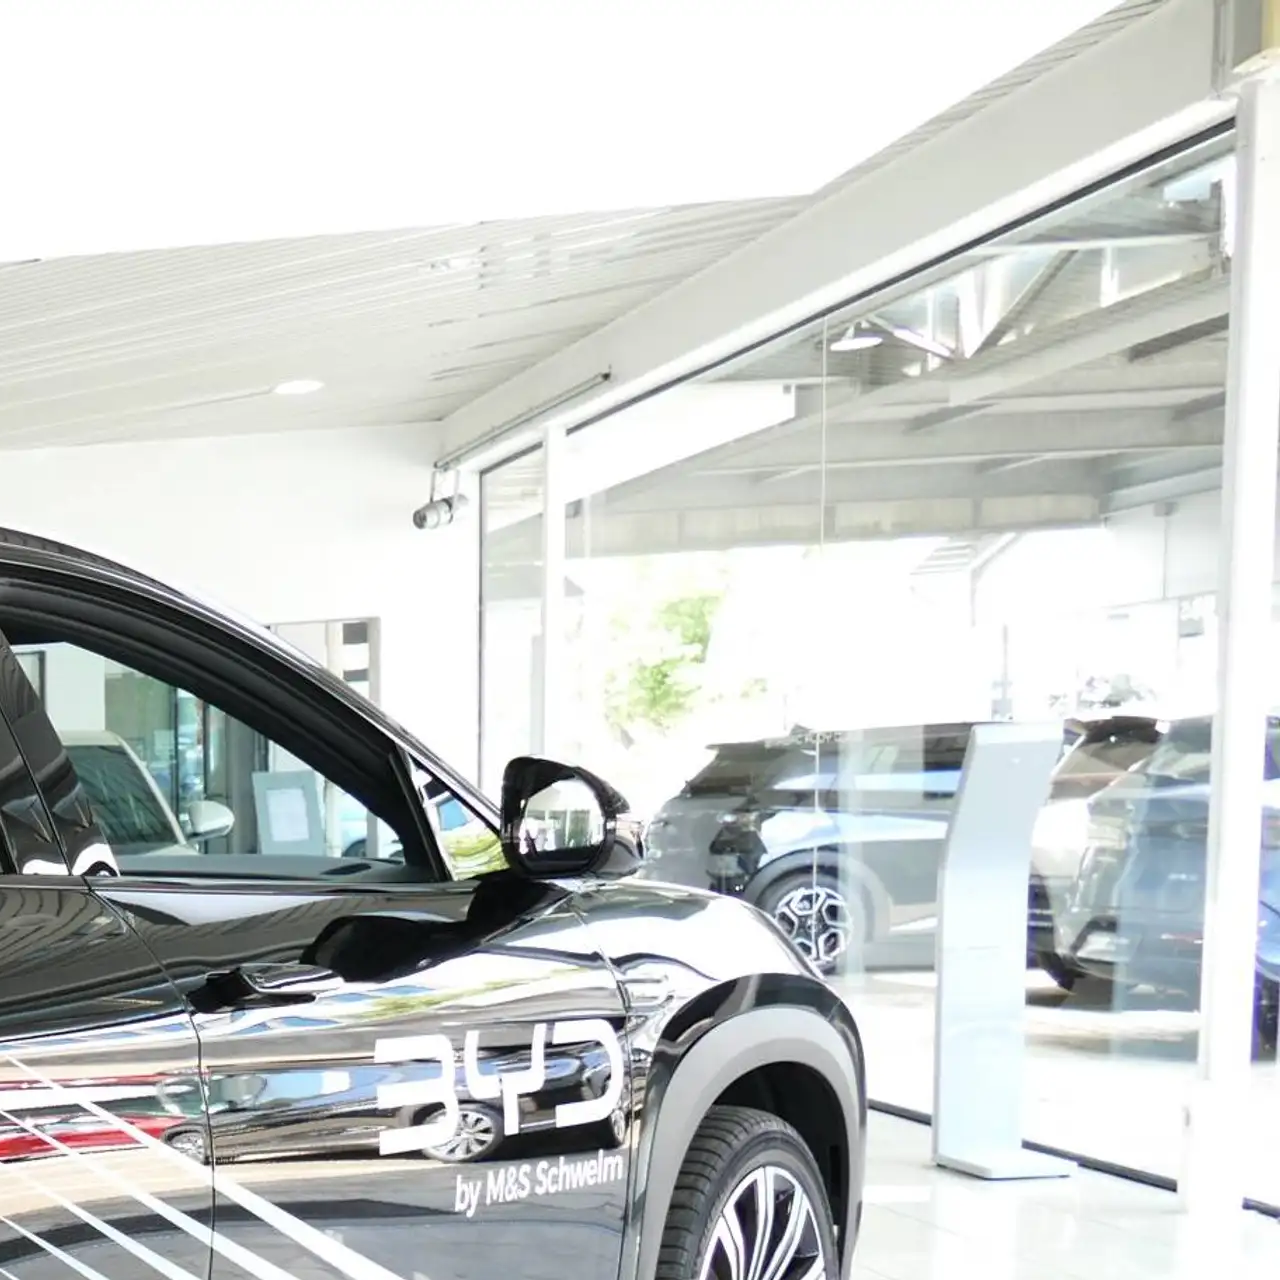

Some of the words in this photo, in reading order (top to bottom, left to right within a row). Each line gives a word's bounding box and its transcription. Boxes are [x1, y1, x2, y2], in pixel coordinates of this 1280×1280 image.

[374, 1018, 624, 1156] BYD
[454, 1175, 482, 1218] by
[486, 1163, 532, 1206] M&S
[535, 1149, 624, 1197] Schwelm
